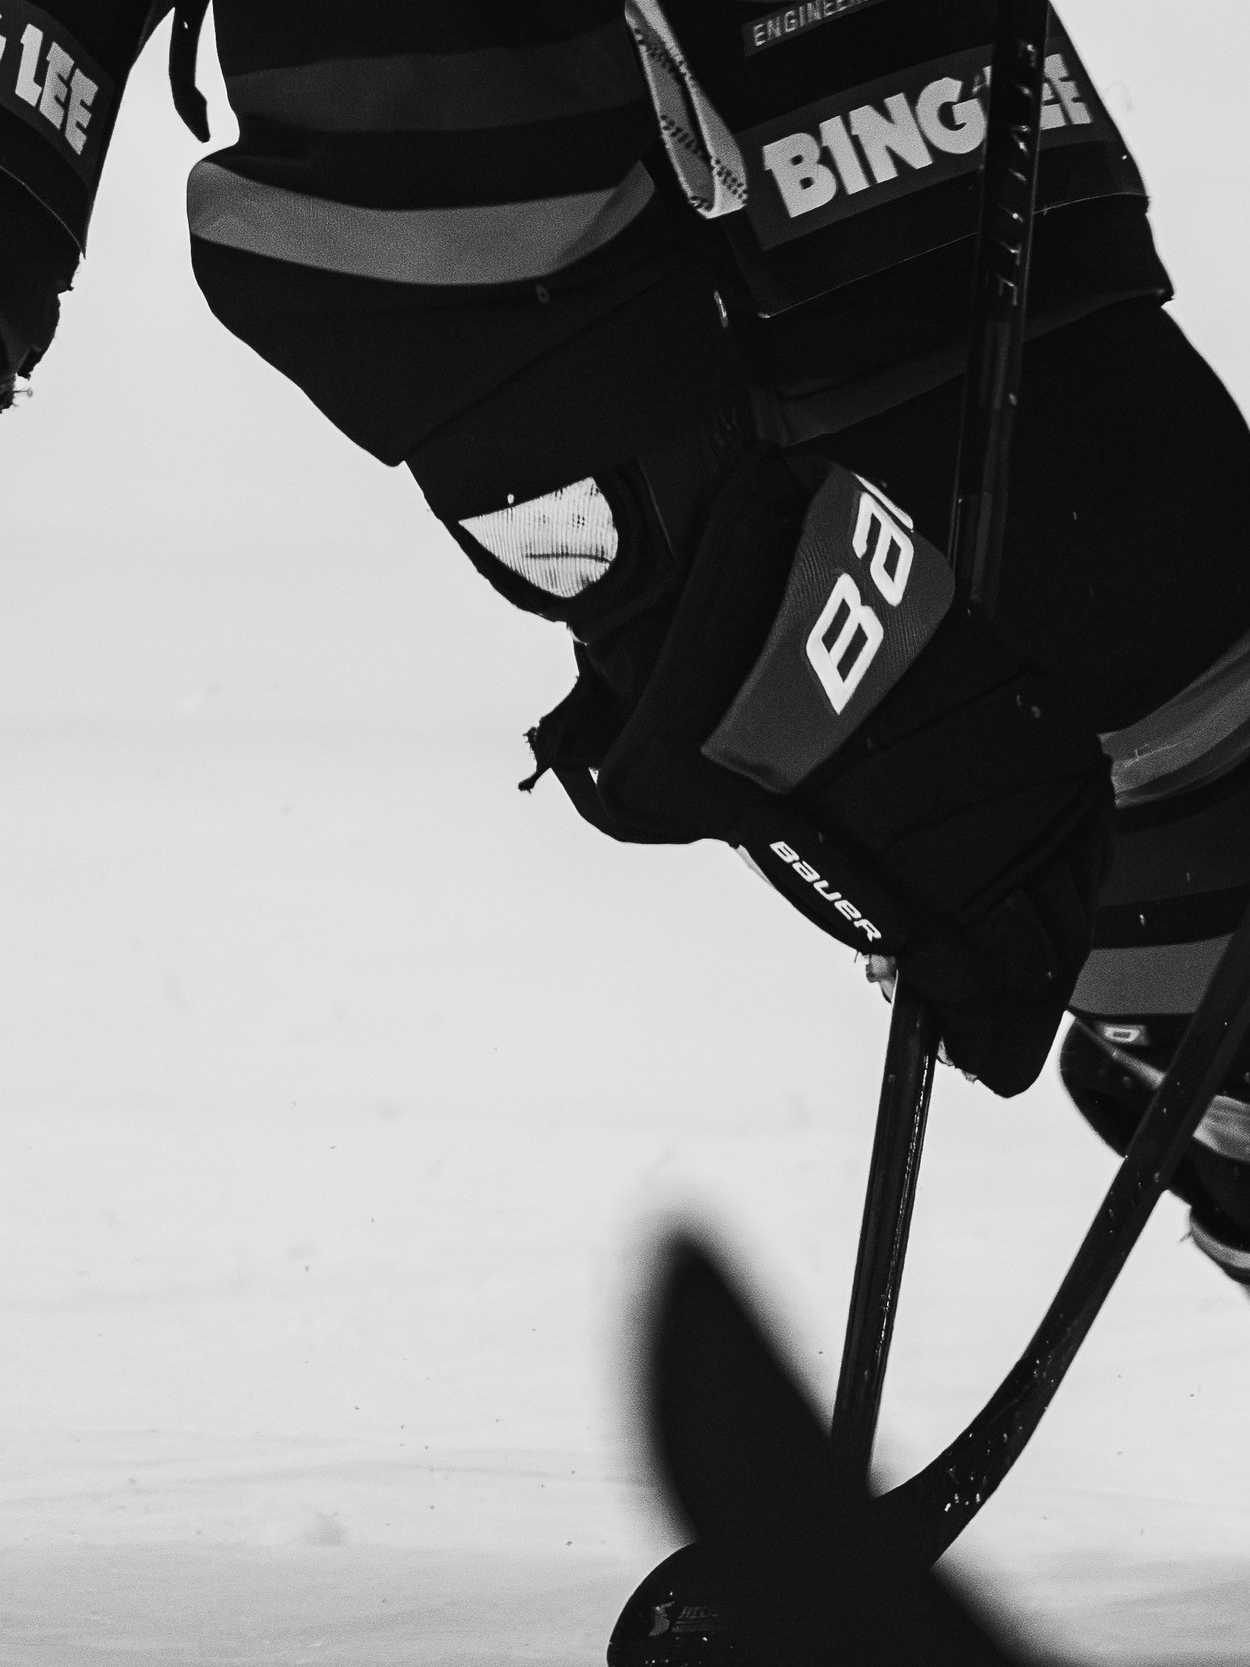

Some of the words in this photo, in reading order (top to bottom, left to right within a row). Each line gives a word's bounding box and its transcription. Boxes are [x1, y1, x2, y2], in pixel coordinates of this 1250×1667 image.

[15, 23, 99, 155] LEE
[763, 71, 987, 217] BING
[770, 841, 883, 942] BAUER
